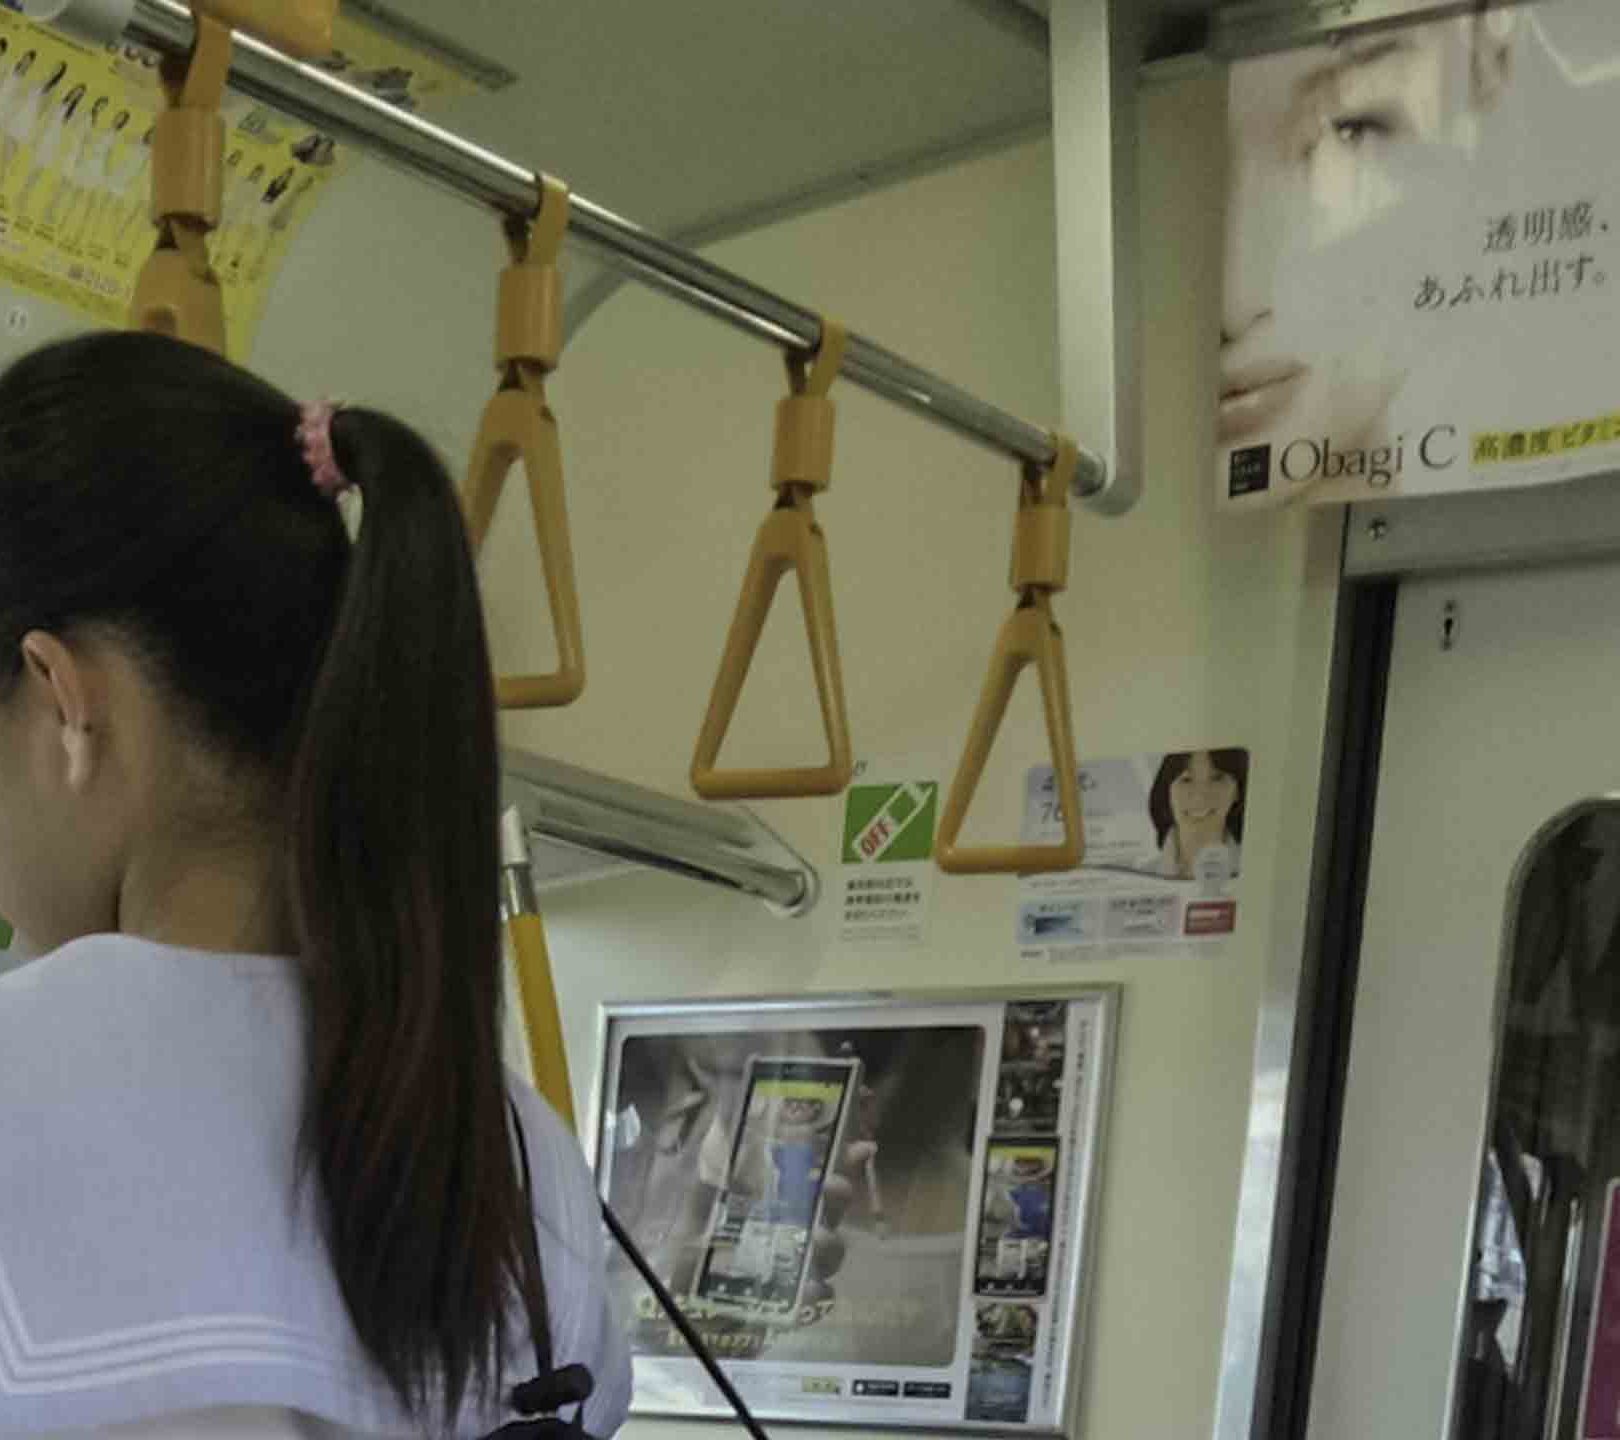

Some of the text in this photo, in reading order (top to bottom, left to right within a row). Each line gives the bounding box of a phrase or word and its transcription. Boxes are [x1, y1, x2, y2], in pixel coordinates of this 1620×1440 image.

[1413, 251, 1607, 310] あふれ出す。
[1280, 436, 1405, 488] Obagi
[1418, 423, 1457, 470] C
[860, 817, 893, 857] OFF
